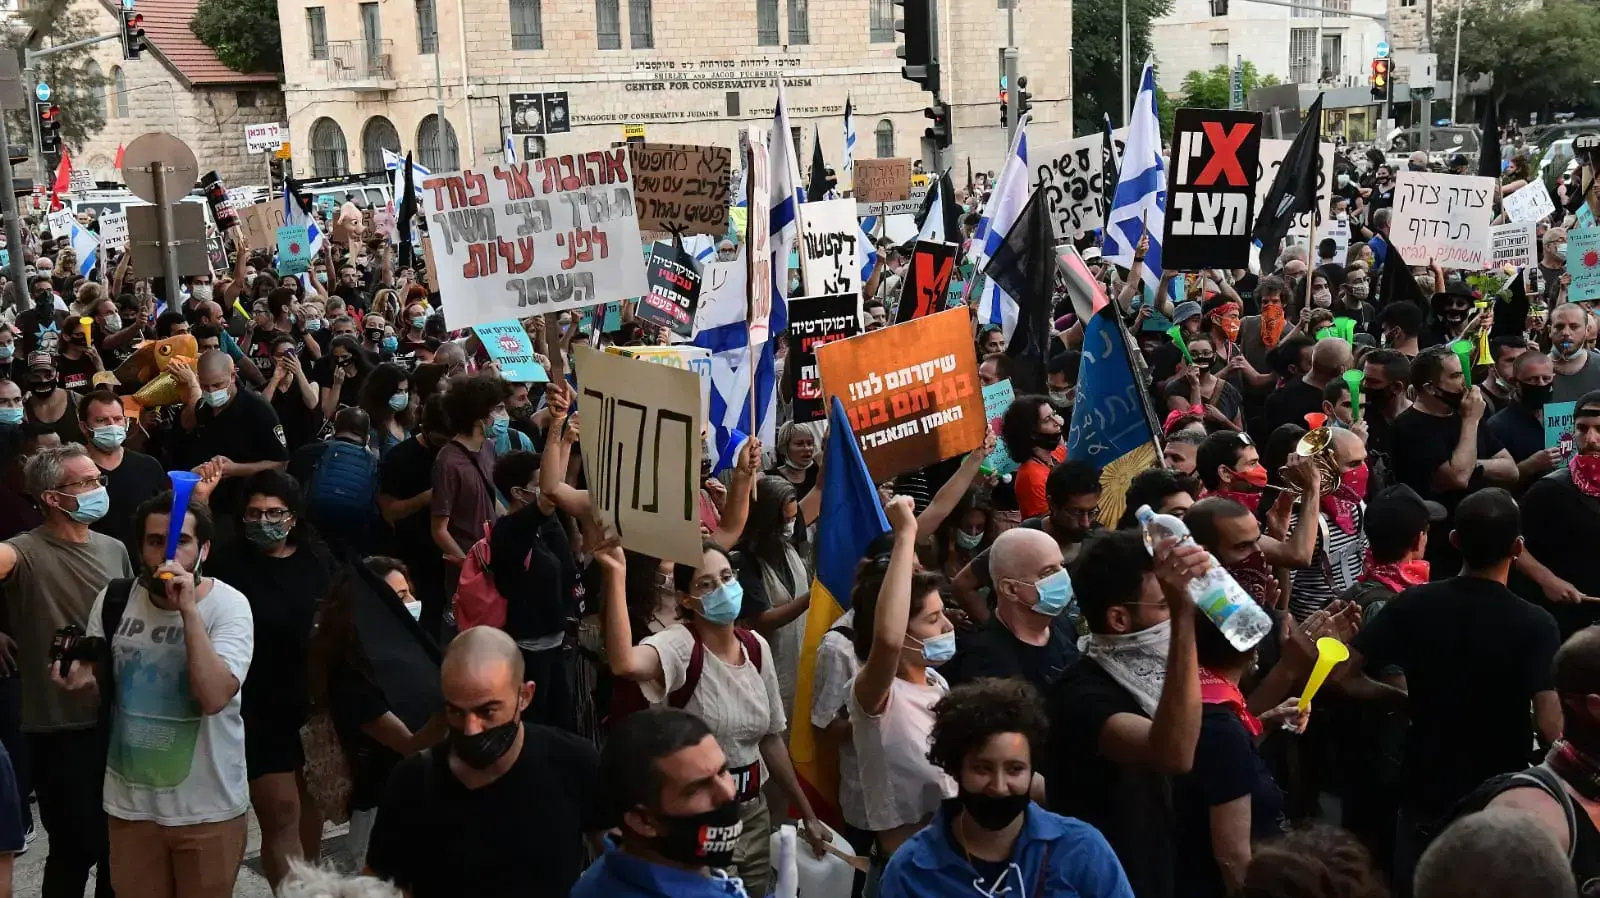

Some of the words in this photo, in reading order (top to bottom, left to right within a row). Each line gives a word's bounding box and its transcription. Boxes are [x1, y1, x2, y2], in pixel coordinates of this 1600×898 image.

[625, 81, 666, 92] CENTER
[669, 81, 690, 91] FOR
[692, 79, 767, 91] CONSERVATIVE
[654, 72, 688, 80] SHIRLEY
[571, 114, 617, 122] SYNAGOGUE
[620, 113, 628, 121] OF
[631, 111, 684, 120] CONSERVATIVE
[535, 148, 629, 195] אהובתי
[630, 150, 688, 171] מחפשי
[696, 146, 728, 175] לא
[422, 169, 490, 212] פחד
[493, 161, 535, 201] אל
[662, 175, 684, 193] עם
[683, 176, 729, 201] לריב
[559, 187, 633, 228] תמיד
[1400, 183, 1441, 214] צדק
[1447, 187, 1488, 215] צדק
[505, 199, 553, 237] הכי
[684, 203, 725, 226] פשוט
[1171, 192, 1248, 236] מצב
[433, 207, 497, 255] חשוך
[1408, 218, 1470, 246] תרדוף
[463, 235, 535, 279] עלות
[556, 225, 609, 271] לפני
[653, 254, 701, 284] דמוקרטיה
[658, 268, 693, 291] עכשיו
[505, 271, 595, 308] השחר
[648, 294, 672, 311] פעם!
[653, 284, 690, 308] סיפוח
[674, 306, 688, 321] אף
[791, 314, 855, 336] דמוקרטיה
[479, 328, 493, 336] את
[493, 326, 521, 334] עוצרים
[848, 371, 883, 401] לנו!
[885, 353, 957, 391] שיקרתם
[891, 373, 974, 419] בגדתם
[920, 405, 964, 435] האמון
[1547, 415, 1560, 428] את
[859, 419, 920, 451] התאבד!
[116, 616, 145, 638] IP
[151, 624, 184, 645] CU
